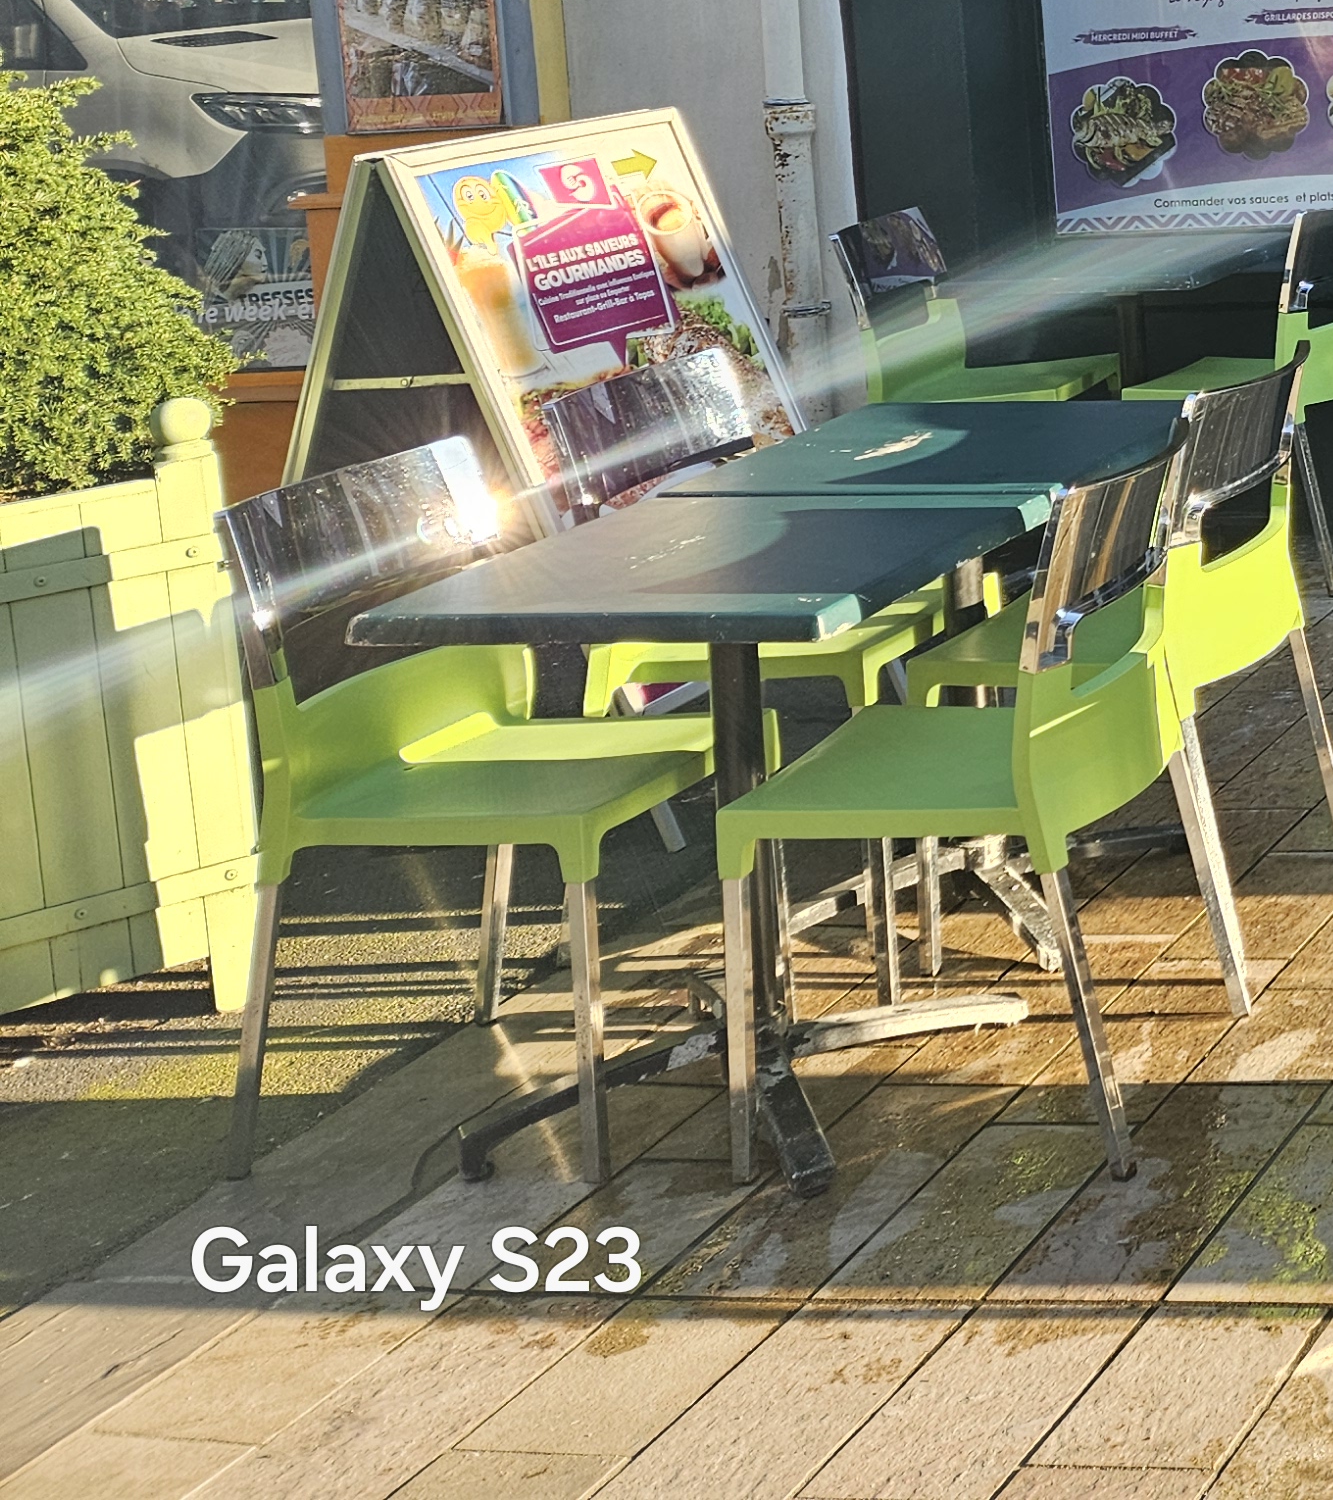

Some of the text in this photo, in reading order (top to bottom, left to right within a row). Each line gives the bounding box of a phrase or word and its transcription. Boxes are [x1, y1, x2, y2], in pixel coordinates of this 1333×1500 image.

[1153, 197, 1225, 209] Commander
[1227, 196, 1247, 206] vos
[1249, 194, 1289, 205] sauces
[1295, 192, 1306, 203] et
[559, 246, 586, 263] AUX
[585, 233, 639, 258] SAVEURS
[534, 250, 646, 290] GOURMANDES
